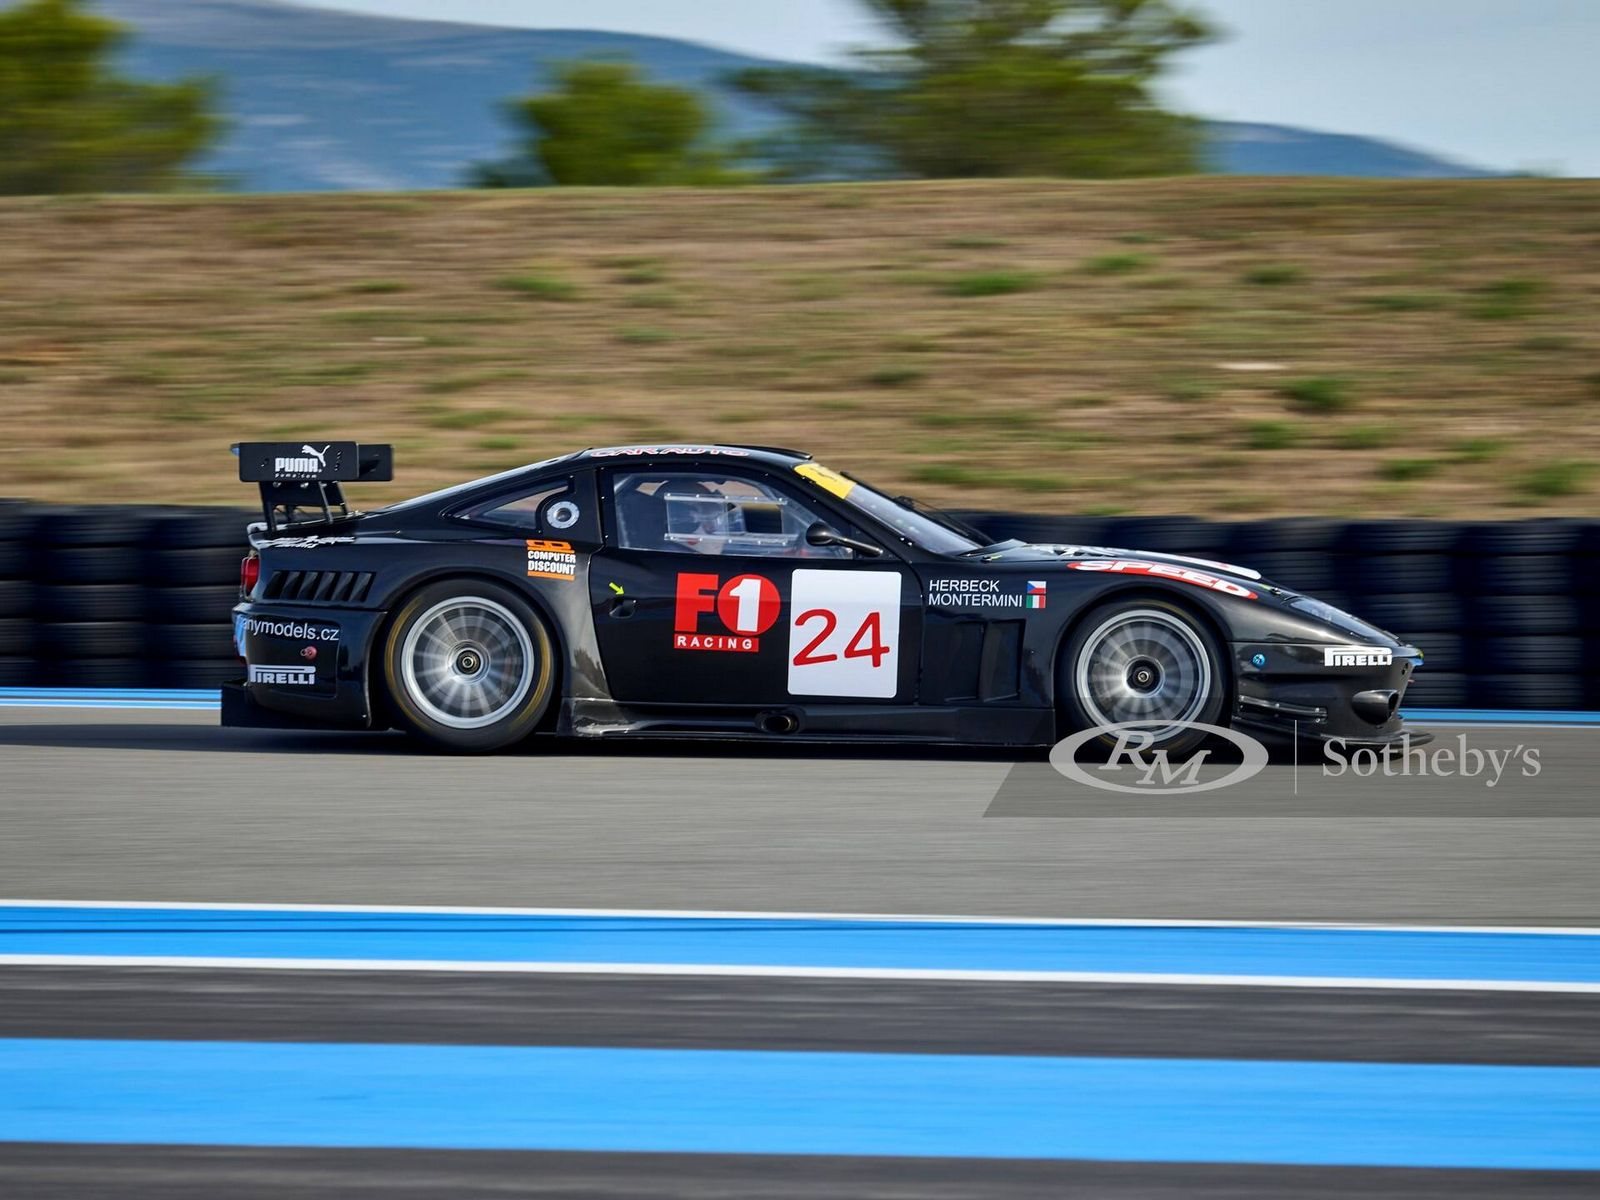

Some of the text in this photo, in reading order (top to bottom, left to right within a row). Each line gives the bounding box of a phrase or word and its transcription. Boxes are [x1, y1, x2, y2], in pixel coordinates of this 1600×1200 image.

[275, 458, 319, 472] PUMA
[527, 550, 576, 563] COMPUTER
[527, 560, 576, 575] DISCOUNT
[929, 579, 1000, 592] HERBECK
[1074, 560, 1256, 598] SPEED
[674, 572, 770, 634] F1
[928, 593, 1023, 607] MONTERMINI
[677, 635, 753, 650] RACING
[793, 608, 890, 668] 24
[1324, 647, 1393, 667] PIRELLI
[249, 664, 317, 685] PIRELLI
